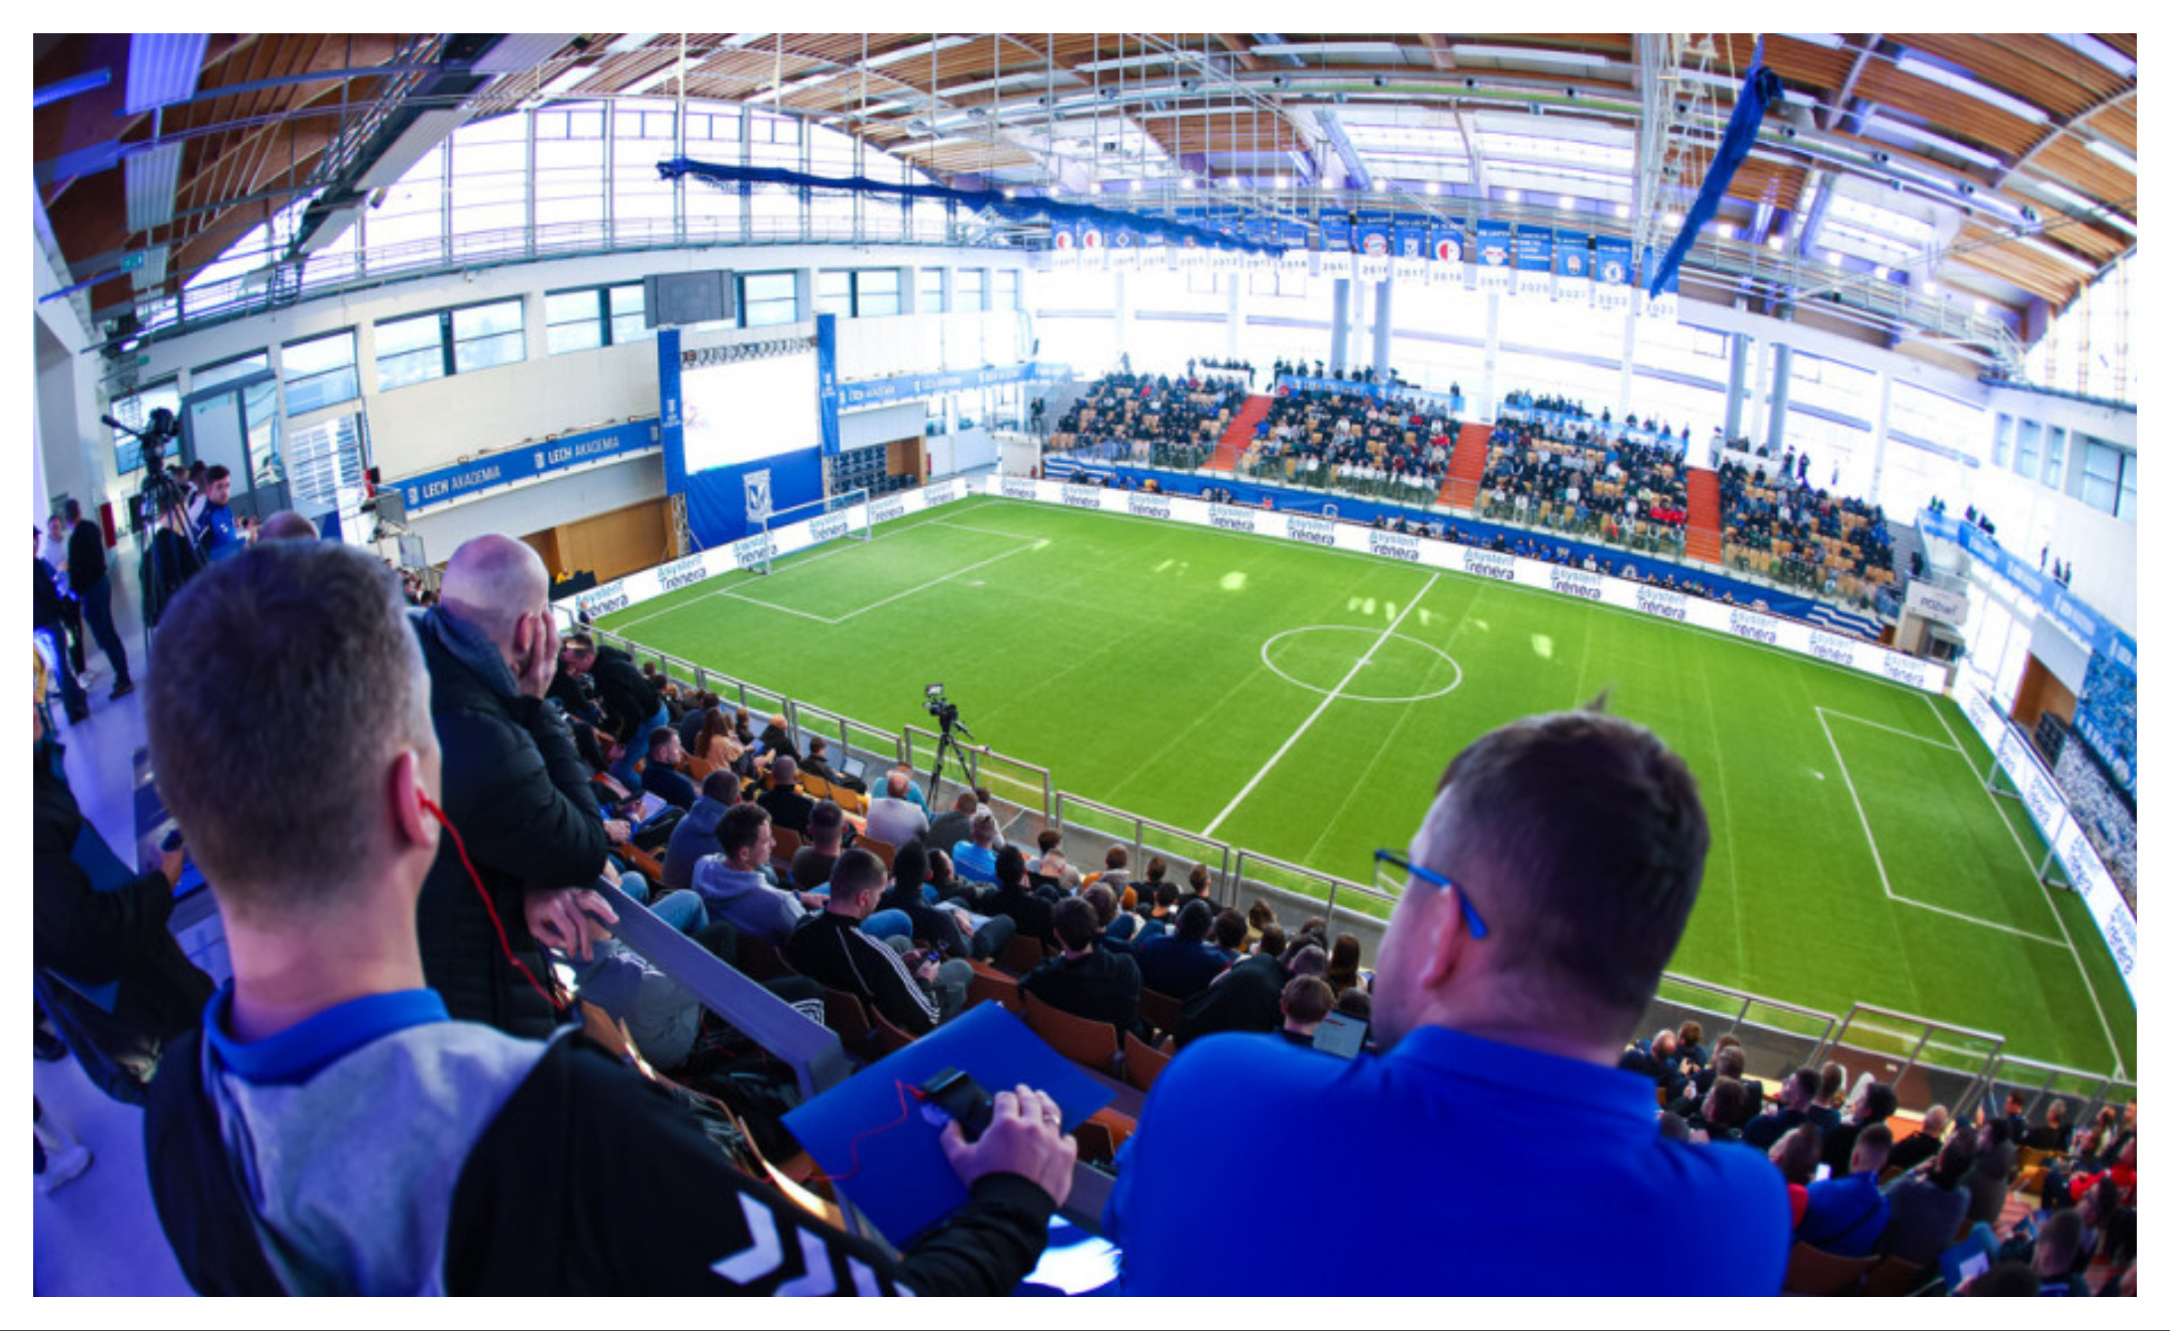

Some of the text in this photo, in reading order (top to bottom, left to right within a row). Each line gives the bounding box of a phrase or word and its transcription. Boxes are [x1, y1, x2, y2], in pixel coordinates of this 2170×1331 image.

[548, 436, 619, 464] LECH AKADEMIA
[423, 465, 501, 498] LECH AKADEMIA
[1064, 493, 1100, 509] Trenera
[1129, 503, 1171, 519] Trenera
[1210, 514, 1255, 532] Trenera
[1288, 527, 1335, 547] Trenera
[1371, 540, 1420, 561] Trenera
[660, 567, 706, 592] Trenera
[1465, 559, 1515, 581] Trenera
[1552, 577, 1602, 601] Trenera
[577, 595, 628, 618] renera
[1637, 597, 1687, 621] Trenera
[1730, 620, 1777, 645] Trenera
[1810, 642, 1854, 666] Trenera
